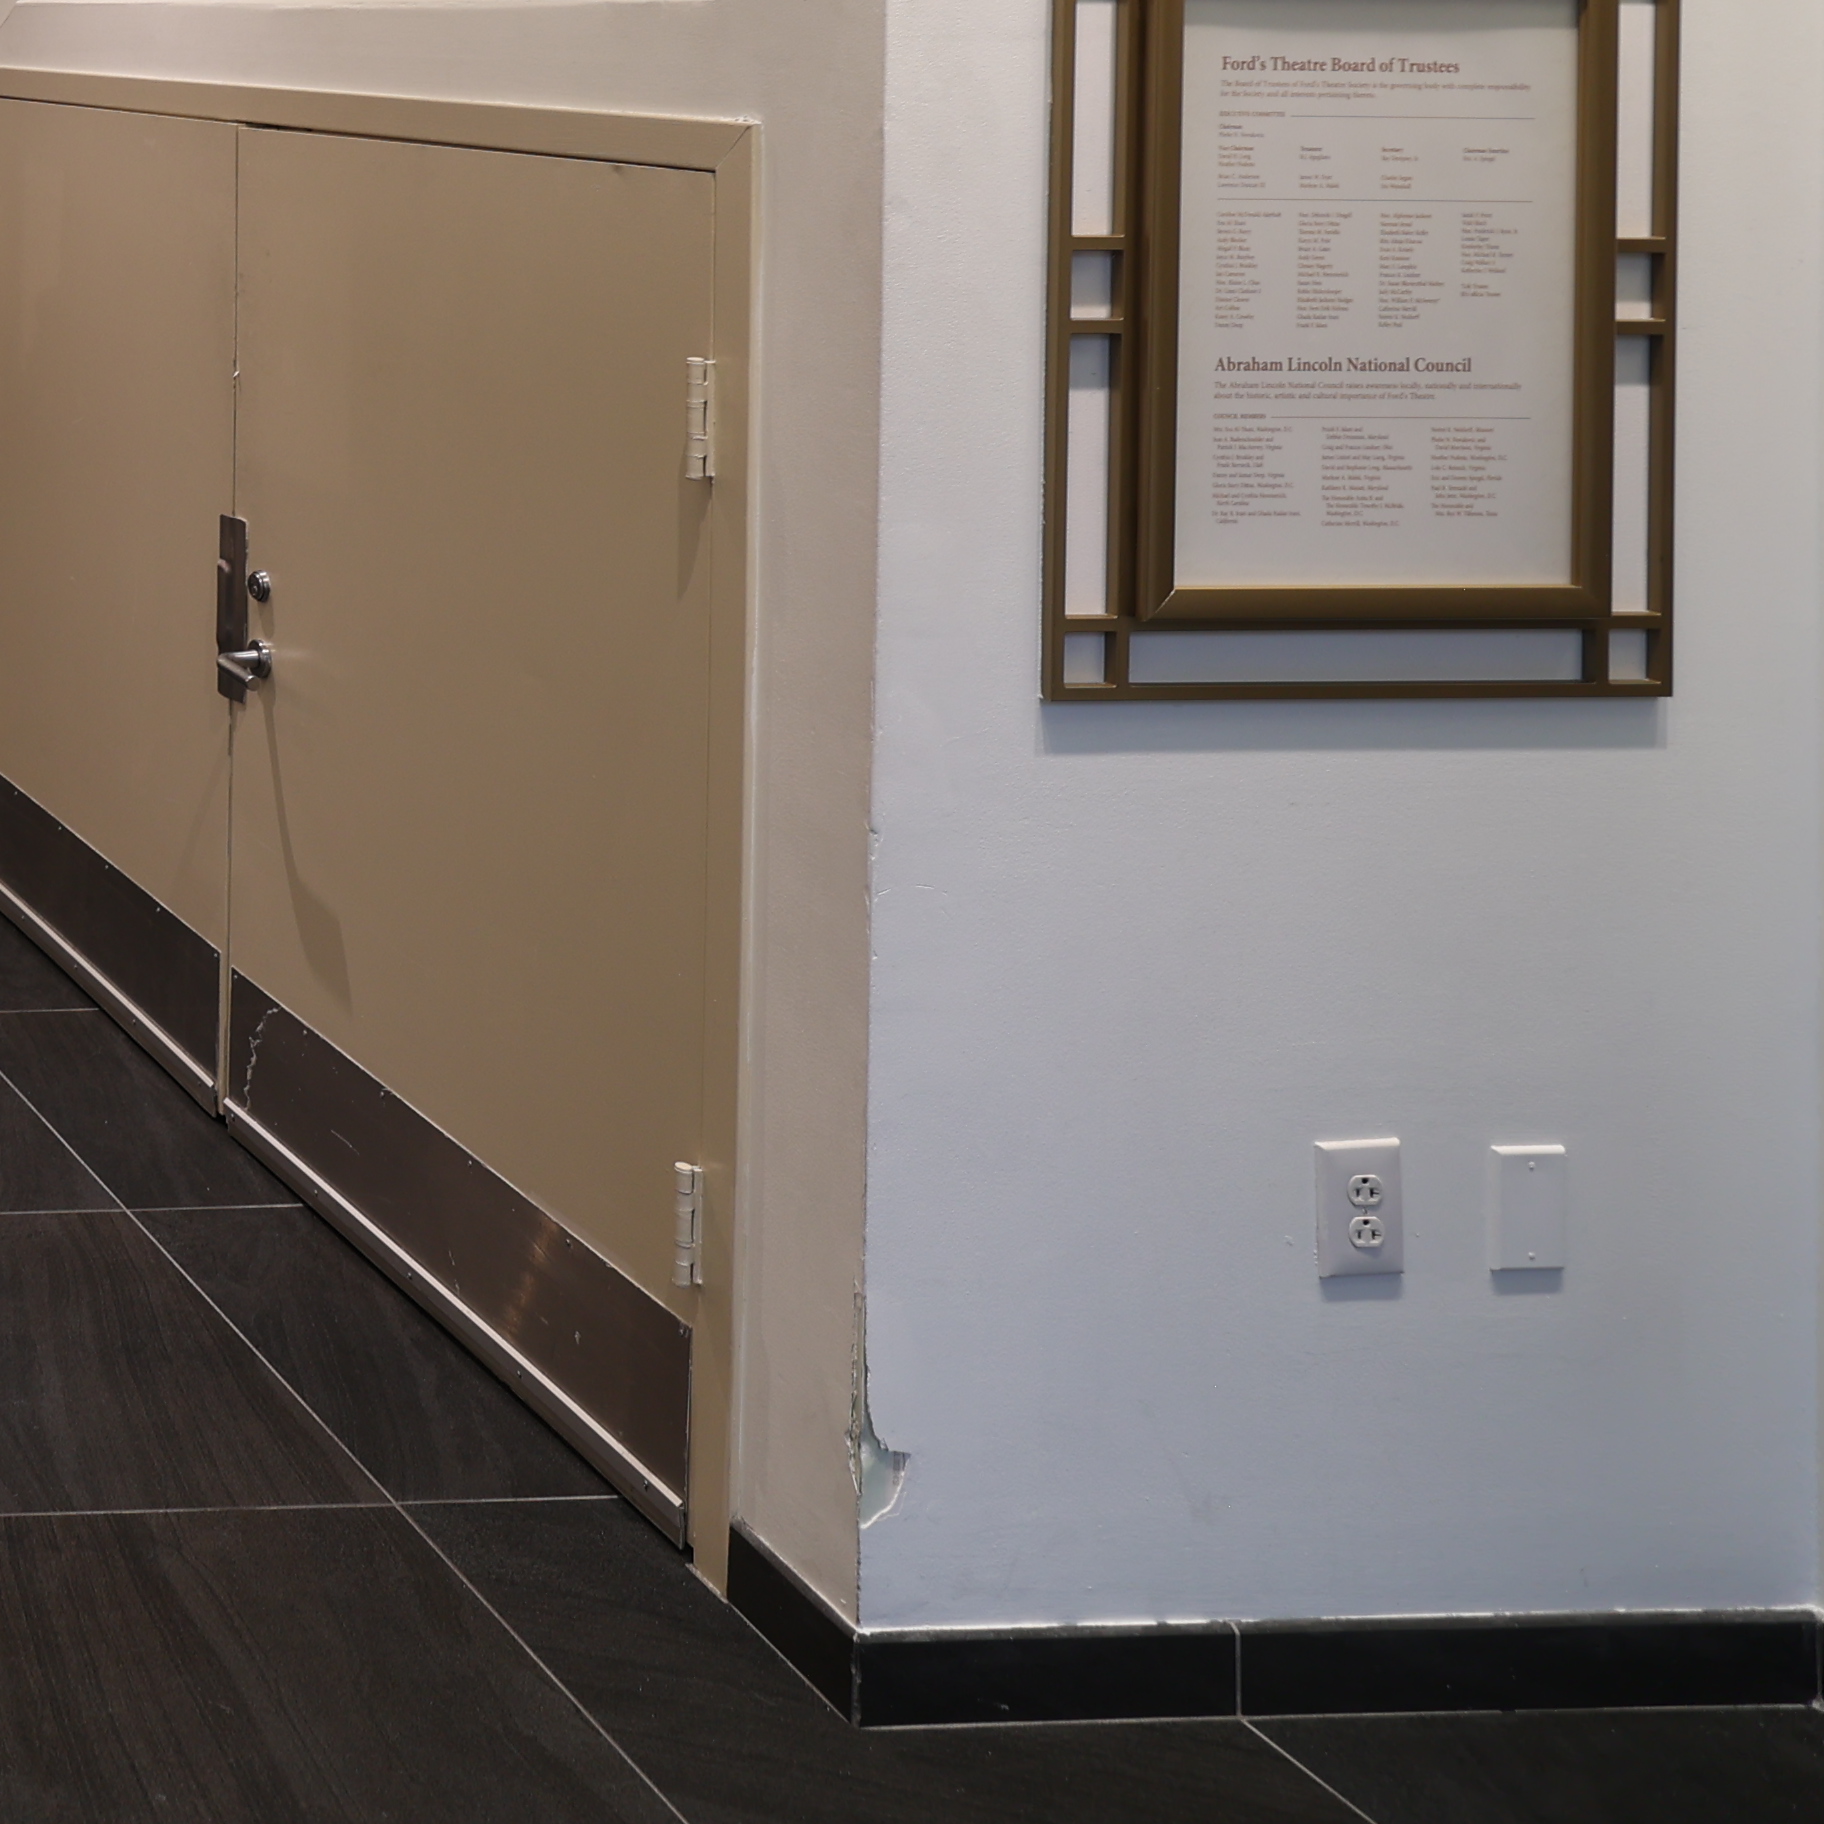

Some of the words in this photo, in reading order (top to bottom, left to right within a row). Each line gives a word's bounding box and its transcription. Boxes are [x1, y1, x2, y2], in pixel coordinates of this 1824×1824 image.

[1221, 56, 1267, 72] Ford's
[1270, 56, 1327, 72] Theatre
[1330, 57, 1376, 72] Board
[1379, 58, 1395, 73] of
[1398, 58, 1460, 73] Trustees
[1214, 356, 1283, 372] Abraham
[1286, 356, 1343, 372] Lincoln
[1346, 357, 1411, 372] National
[1414, 357, 1472, 373] Council
